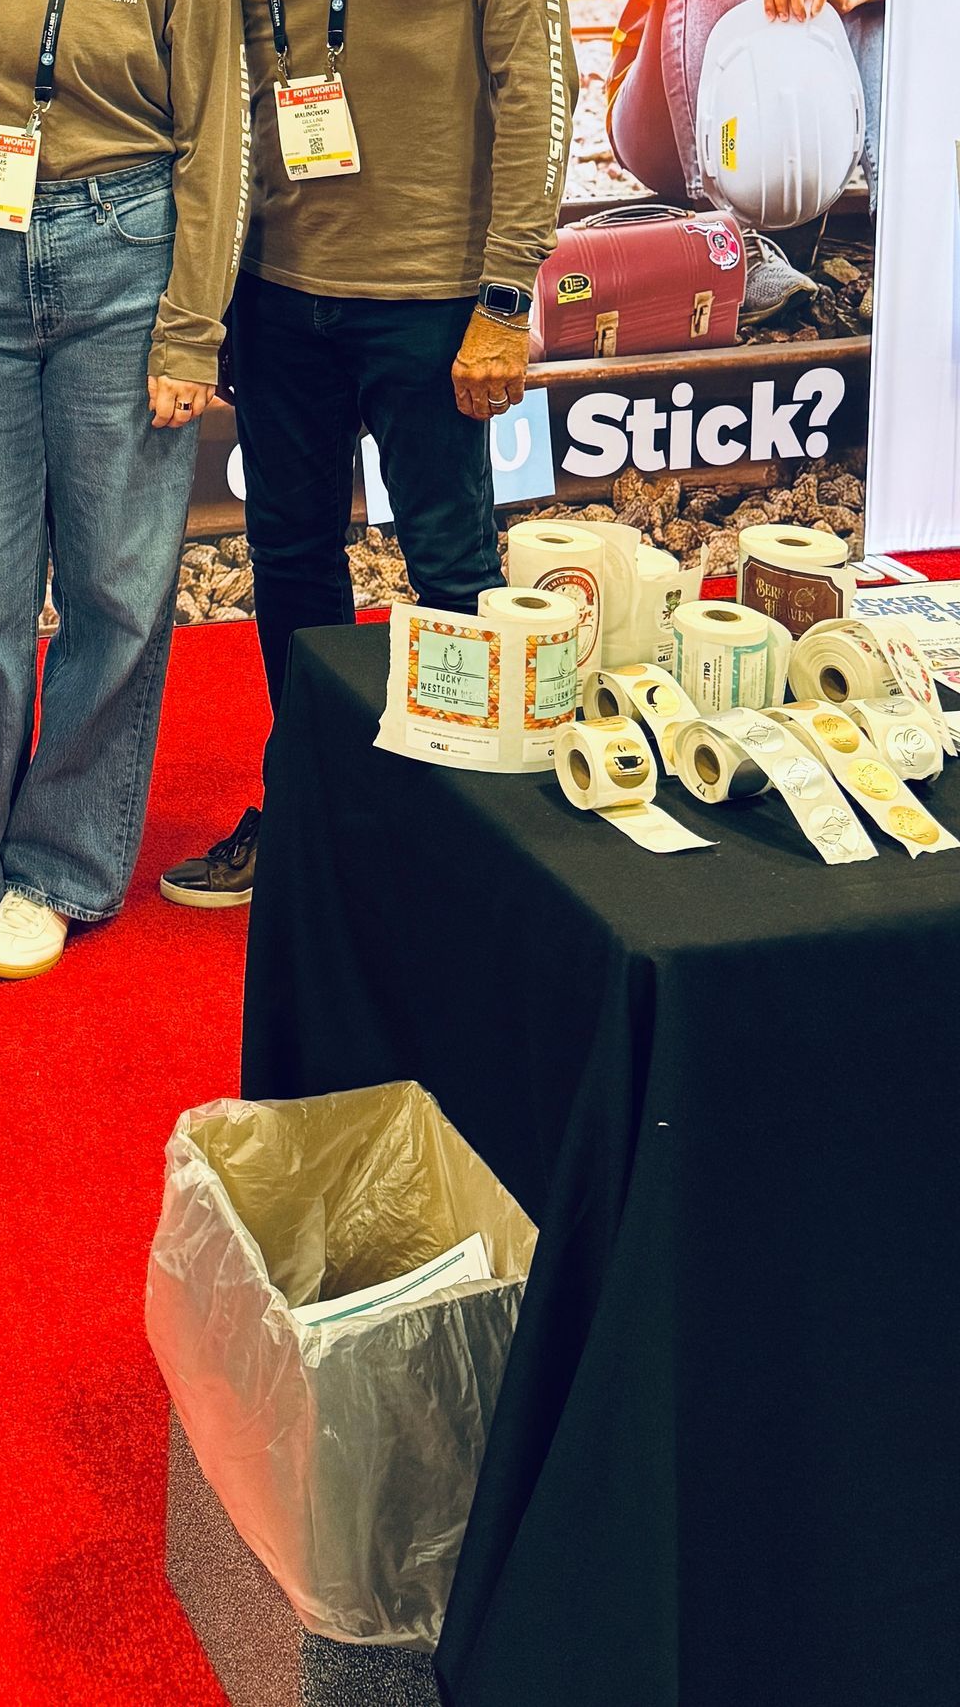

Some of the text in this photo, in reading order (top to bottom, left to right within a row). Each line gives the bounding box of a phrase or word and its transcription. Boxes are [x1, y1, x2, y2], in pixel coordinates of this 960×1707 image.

[293, 85, 340, 98] FORT WORTH
[3, 137, 34, 147] WORTH
[561, 367, 845, 478] Stick?
[545, 577, 570, 591] EMIUM
[853, 595, 933, 608] ICKER
[436, 672, 461, 685] LUCKY
[420, 681, 457, 696] WESTERN
